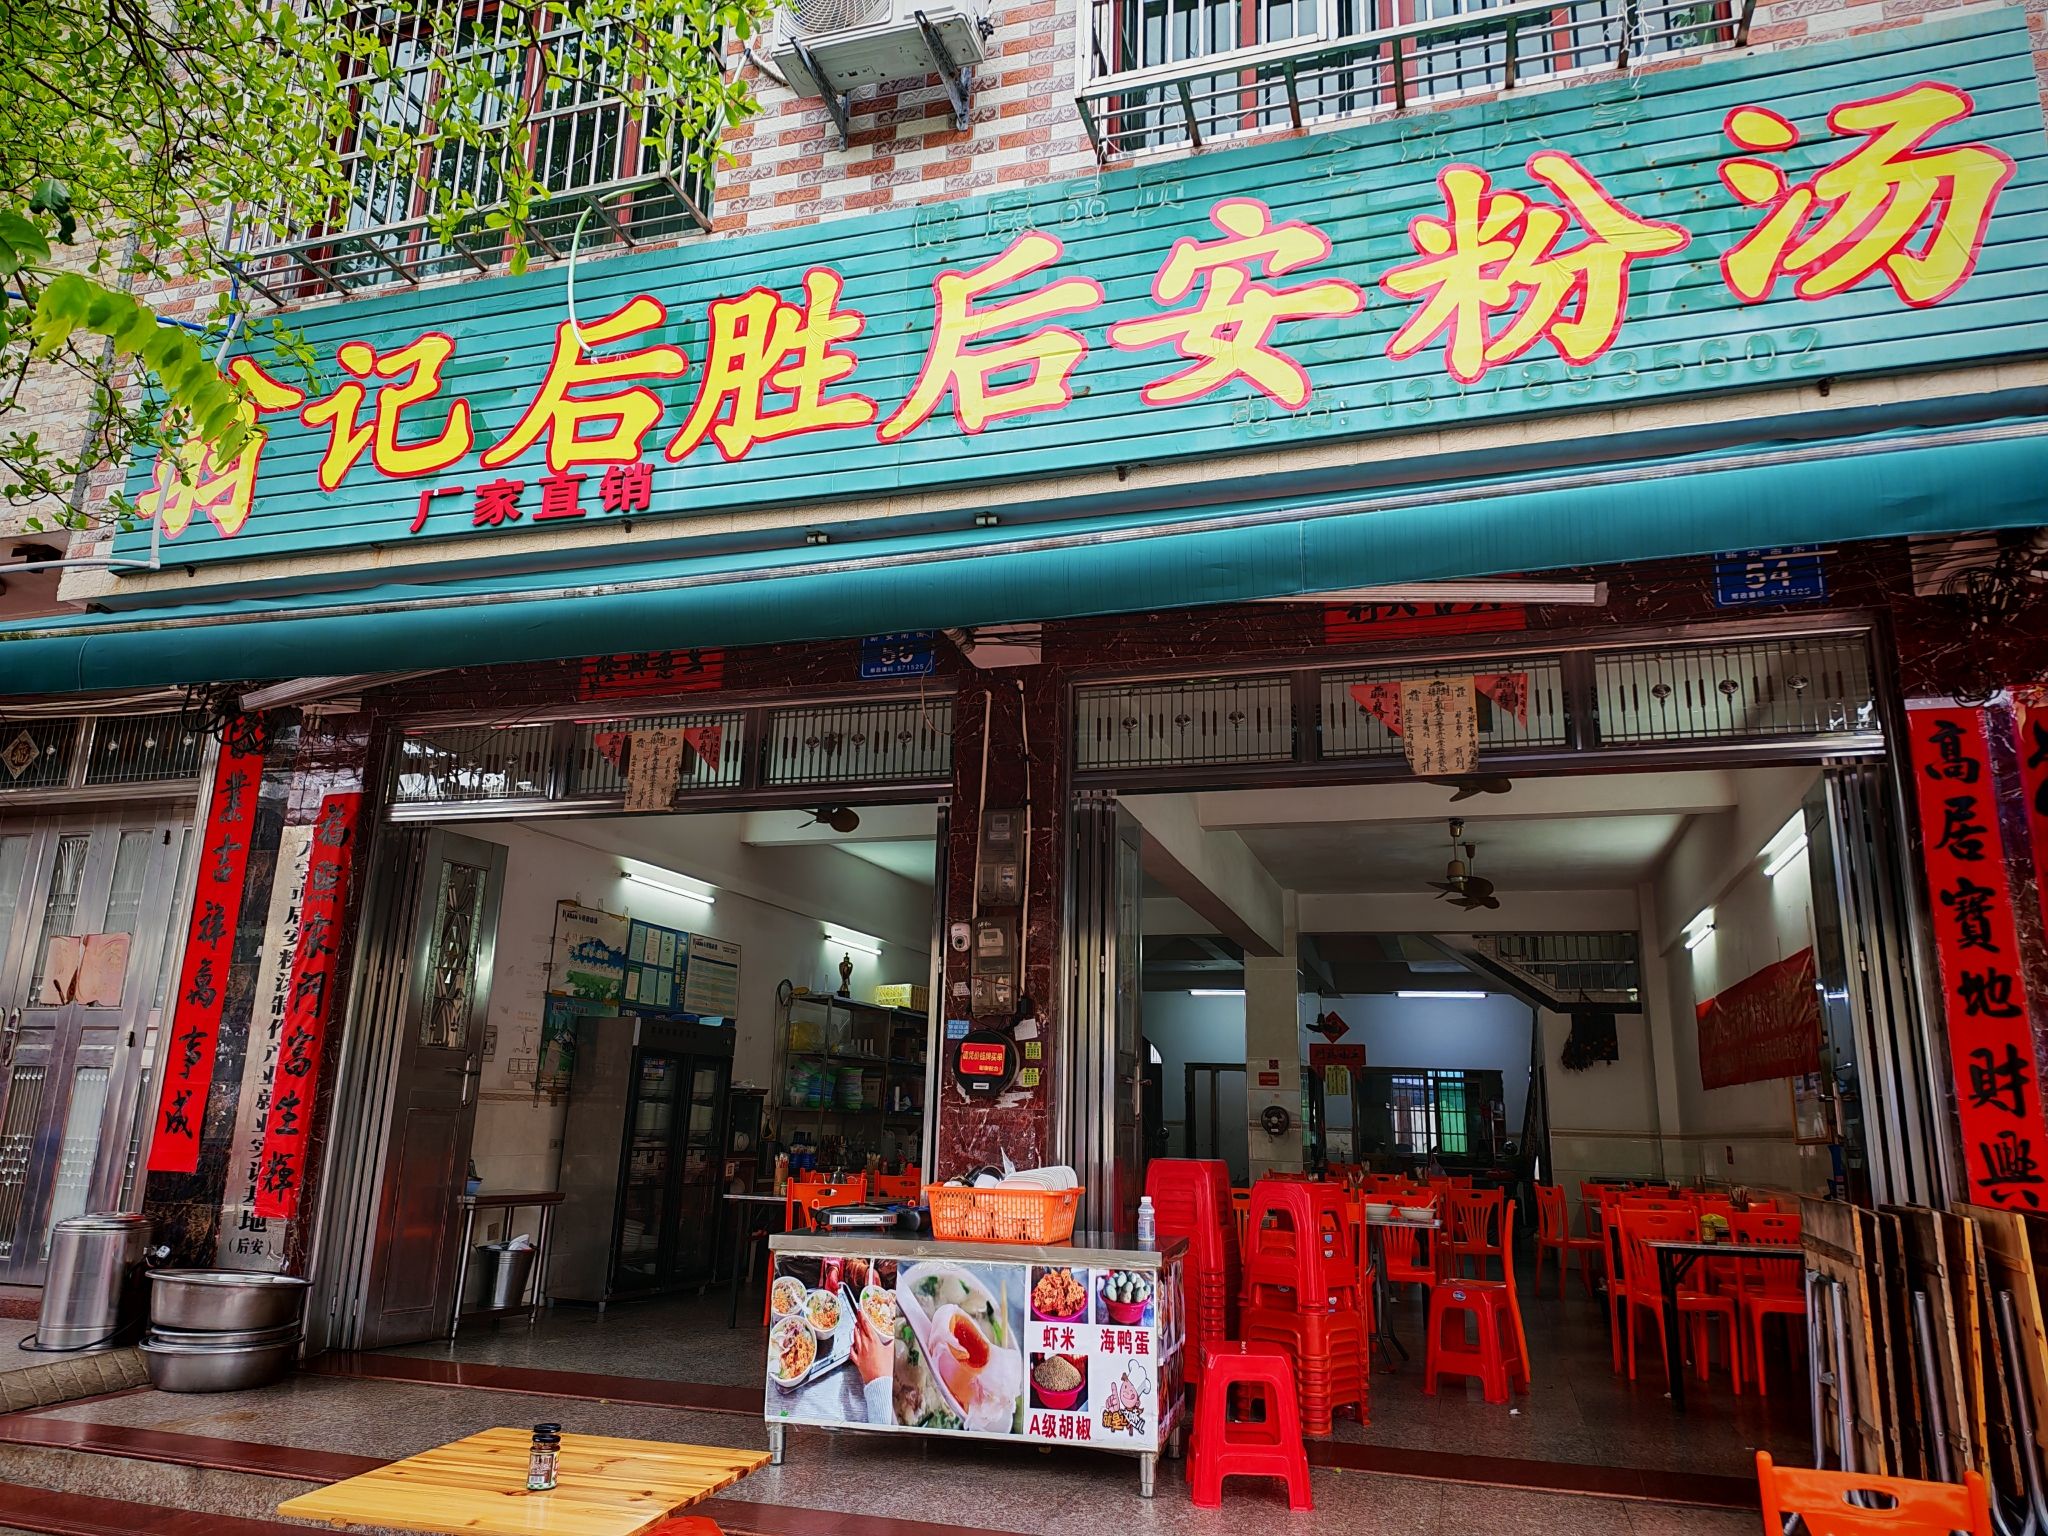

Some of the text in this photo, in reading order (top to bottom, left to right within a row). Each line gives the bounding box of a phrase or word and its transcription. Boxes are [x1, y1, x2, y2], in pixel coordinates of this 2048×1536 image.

[409, 462, 655, 533] 厂家直销
[1745, 560, 1792, 589] 54
[1044, 1325, 1075, 1351] 虾米
[1100, 1329, 1149, 1355] 海鸭蛋
[1029, 1414, 1092, 1441] A级胡椒
